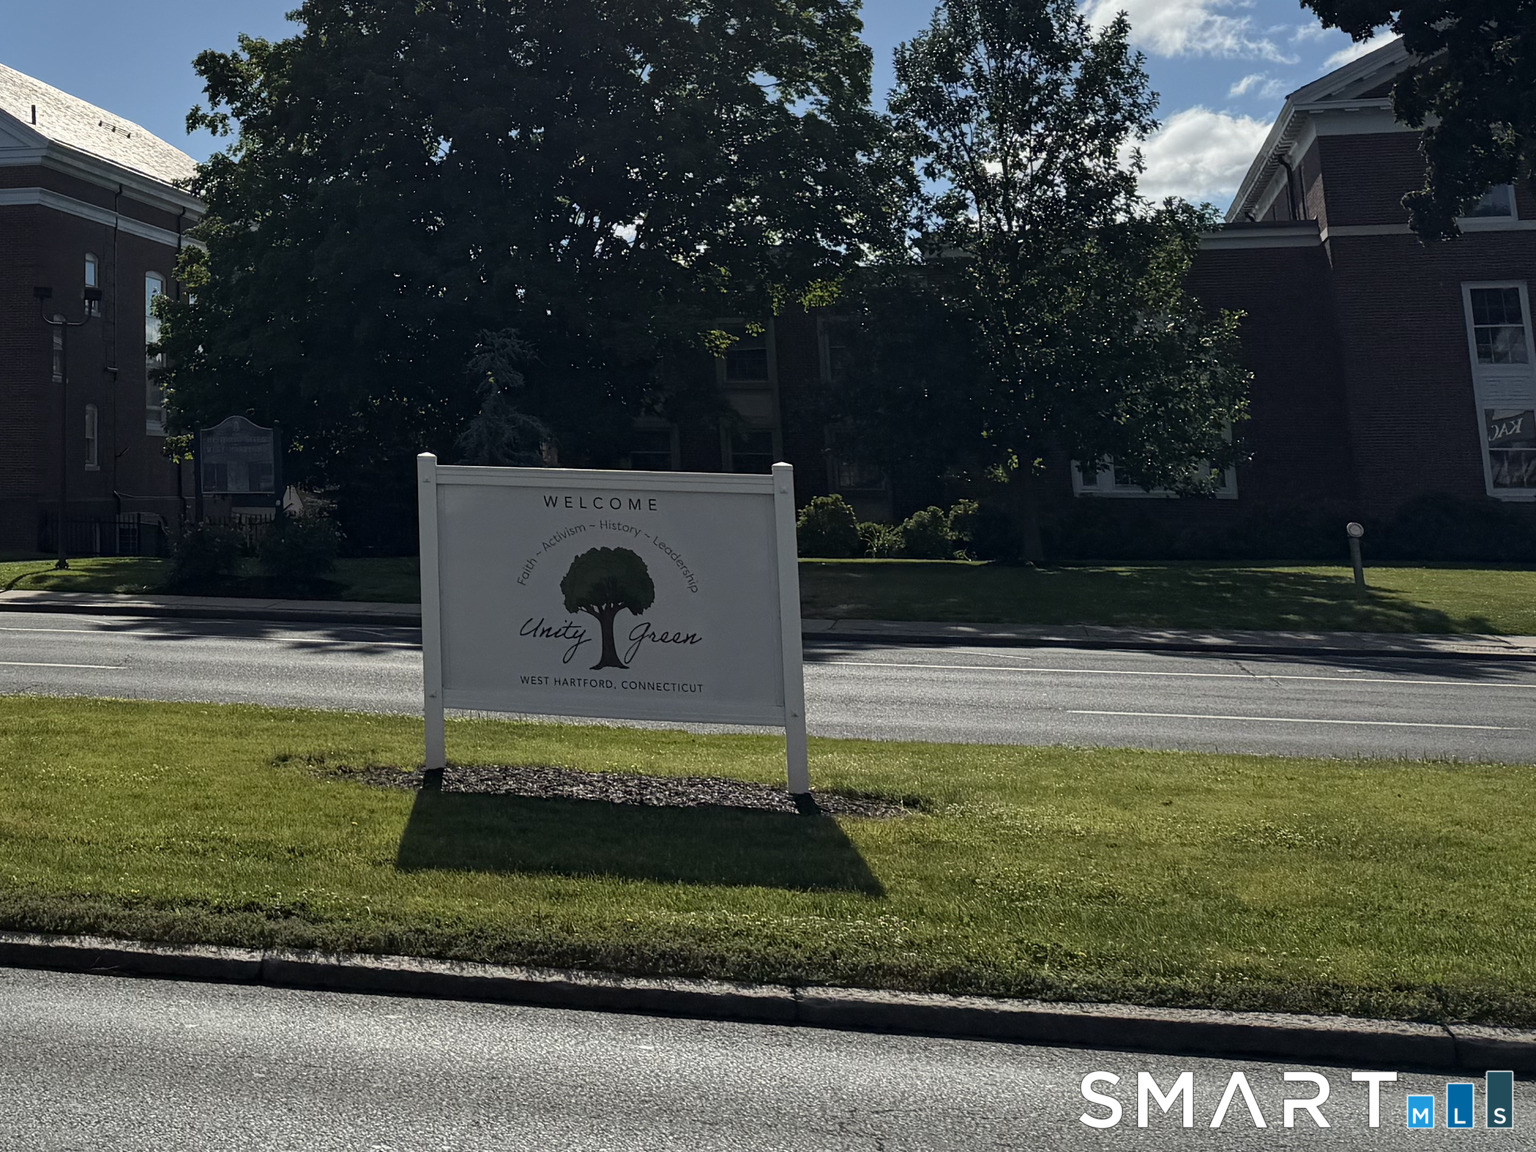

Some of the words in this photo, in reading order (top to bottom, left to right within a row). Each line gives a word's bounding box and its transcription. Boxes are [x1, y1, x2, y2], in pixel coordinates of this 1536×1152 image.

[543, 495, 658, 511] WELCOME
[517, 558, 537, 586] Faith
[541, 523, 586, 552] Activism
[599, 520, 642, 538] History
[652, 536, 699, 594] Leadership
[519, 617, 592, 664] Unity
[623, 622, 702, 665] Green
[519, 675, 550, 686] WEST
[553, 678, 617, 690] HARTFORD,
[621, 680, 704, 694] CONNECTICUT
